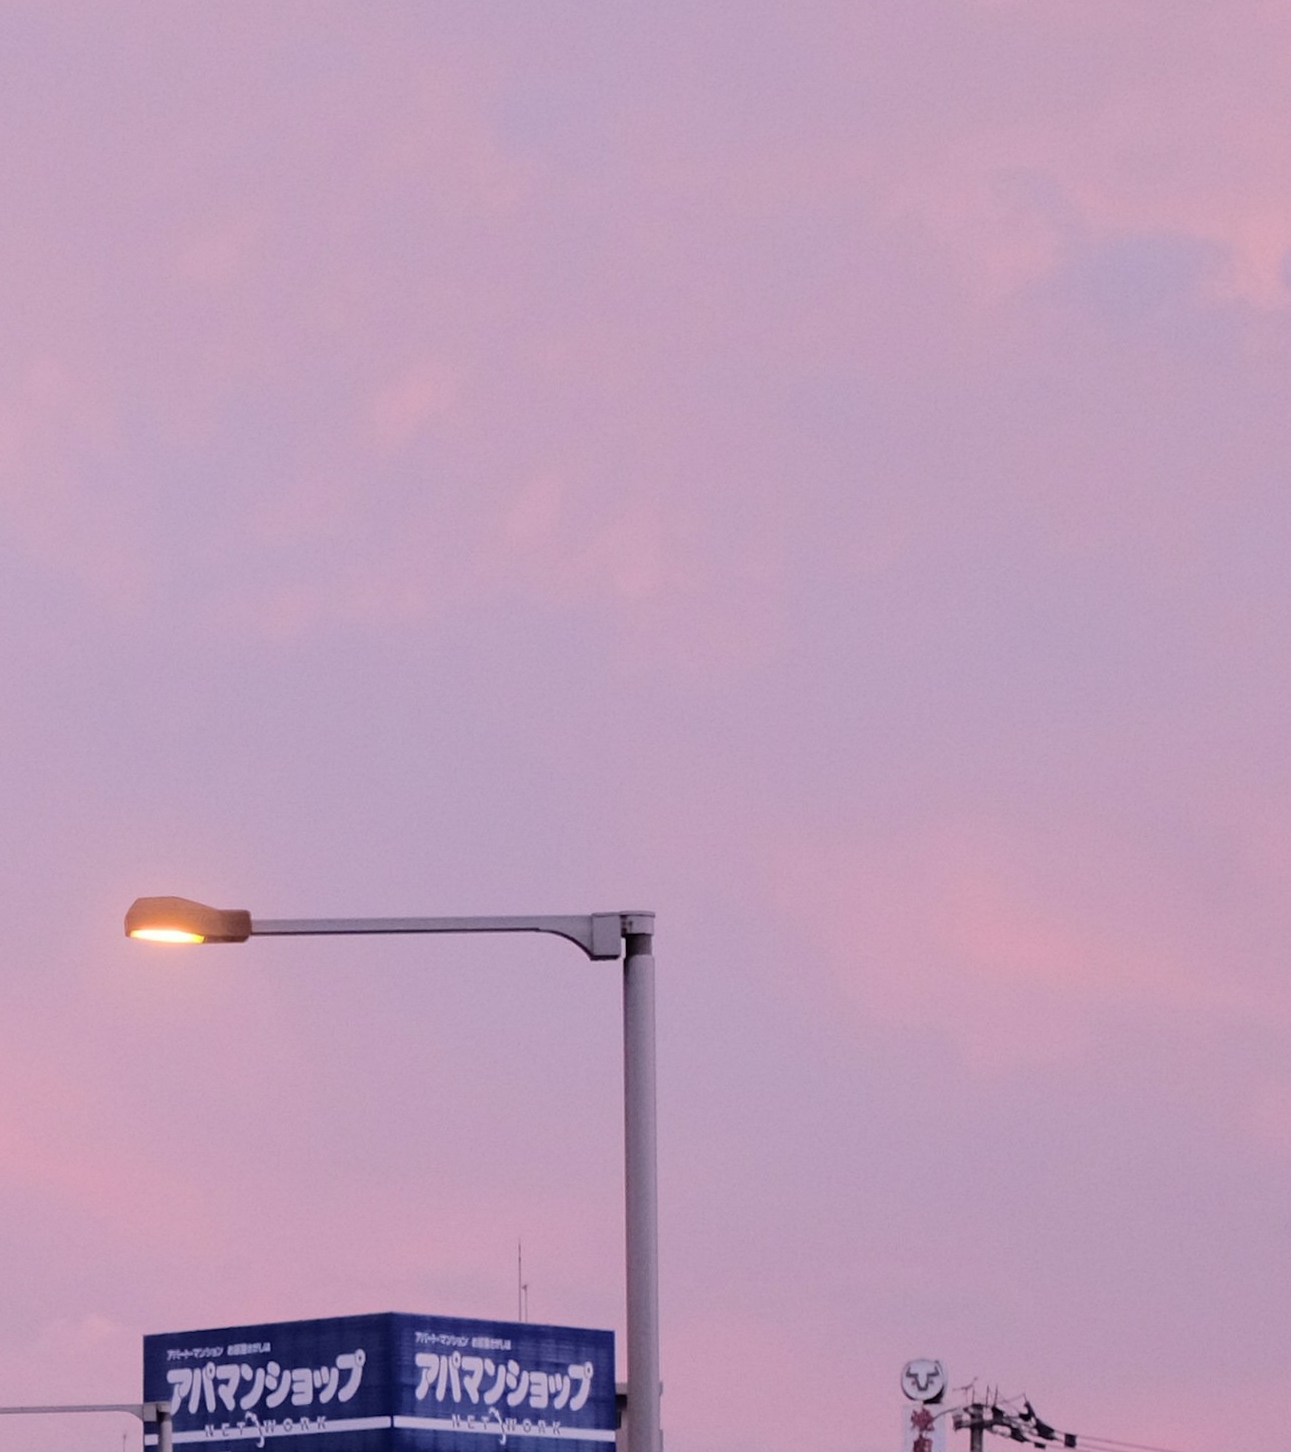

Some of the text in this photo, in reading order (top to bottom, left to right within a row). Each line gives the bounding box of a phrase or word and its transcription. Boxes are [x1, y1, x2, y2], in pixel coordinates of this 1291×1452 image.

[166, 1348, 366, 1416] アパマンショップ
[415, 1351, 594, 1411] アパマンショップ
